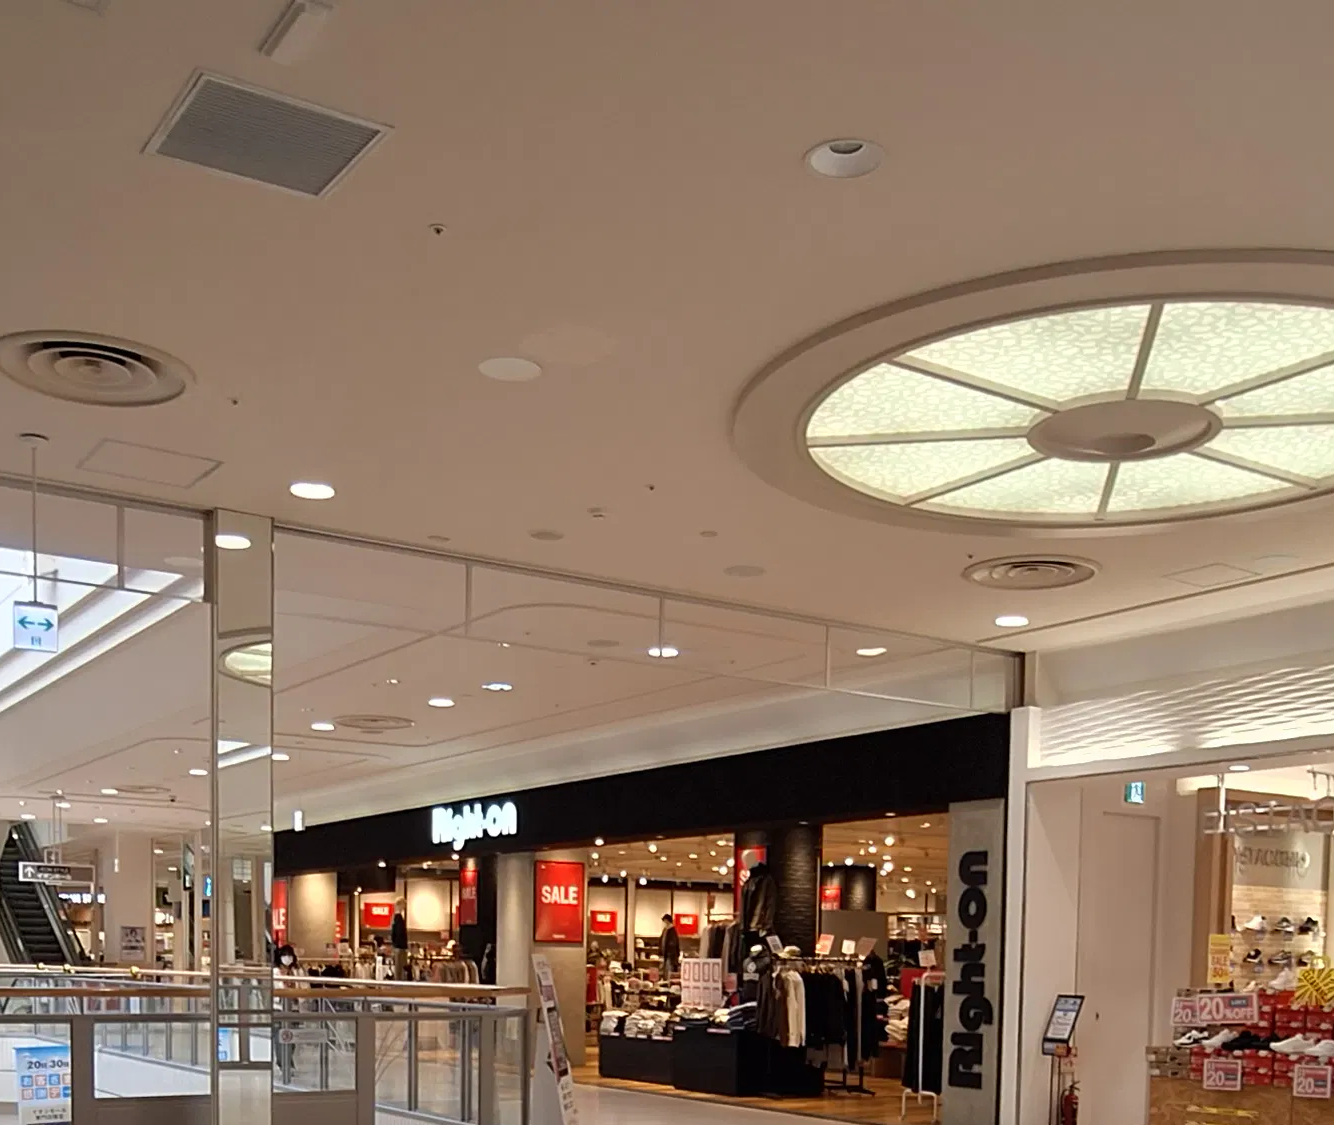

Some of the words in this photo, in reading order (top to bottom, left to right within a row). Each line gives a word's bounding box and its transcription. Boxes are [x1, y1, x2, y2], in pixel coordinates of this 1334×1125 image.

[541, 885, 579, 905] SALE
[948, 850, 994, 1090] Right-on
[1206, 1071, 1225, 1087] 20
[1297, 1079, 1315, 1093] 20
